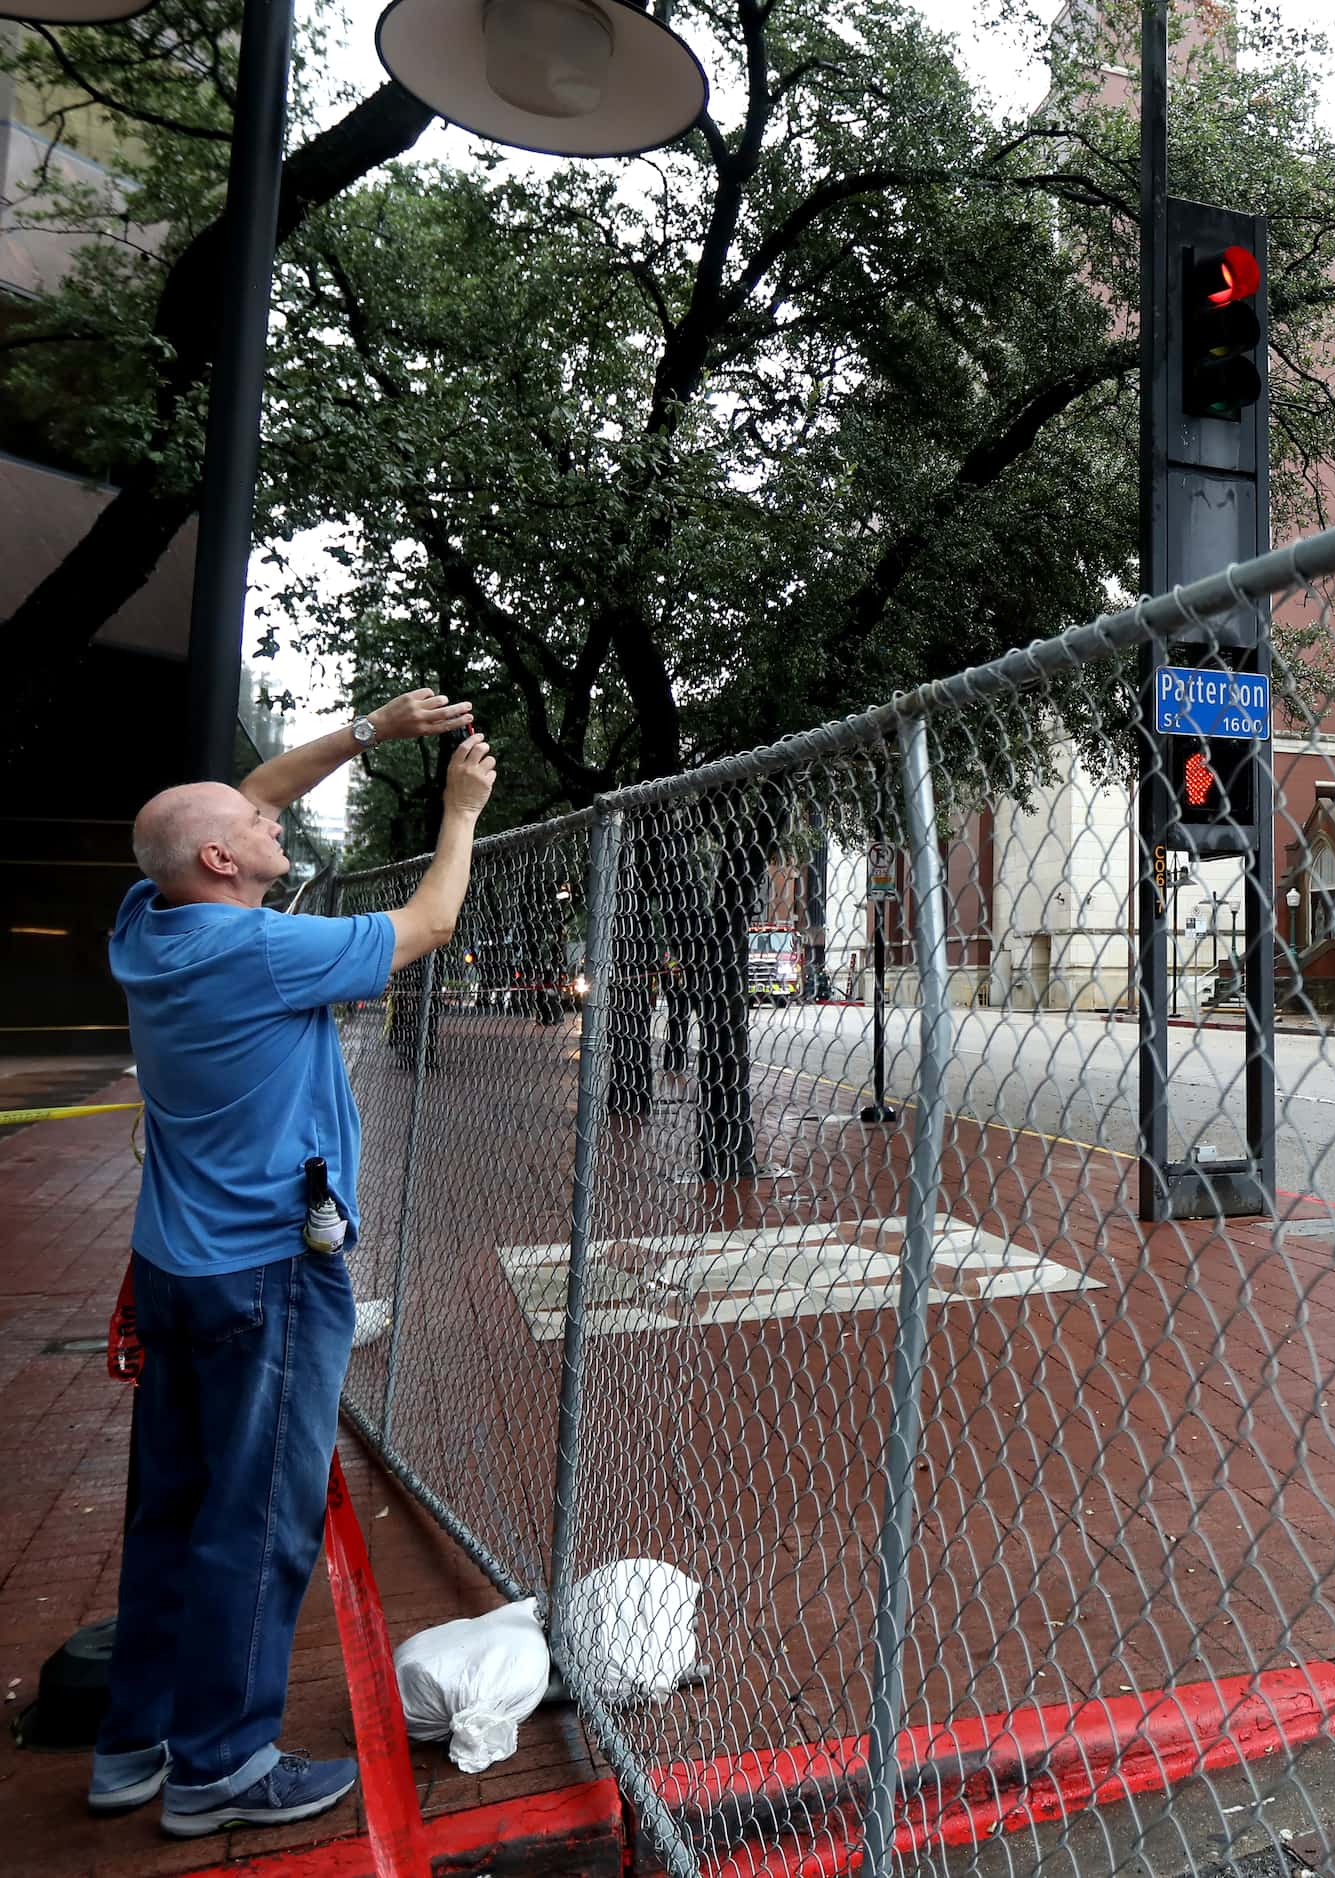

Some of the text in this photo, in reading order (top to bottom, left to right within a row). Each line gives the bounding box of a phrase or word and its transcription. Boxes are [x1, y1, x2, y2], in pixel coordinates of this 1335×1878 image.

[1161, 673, 1265, 708] Patterson
[1163, 712, 1263, 734] St 1600
